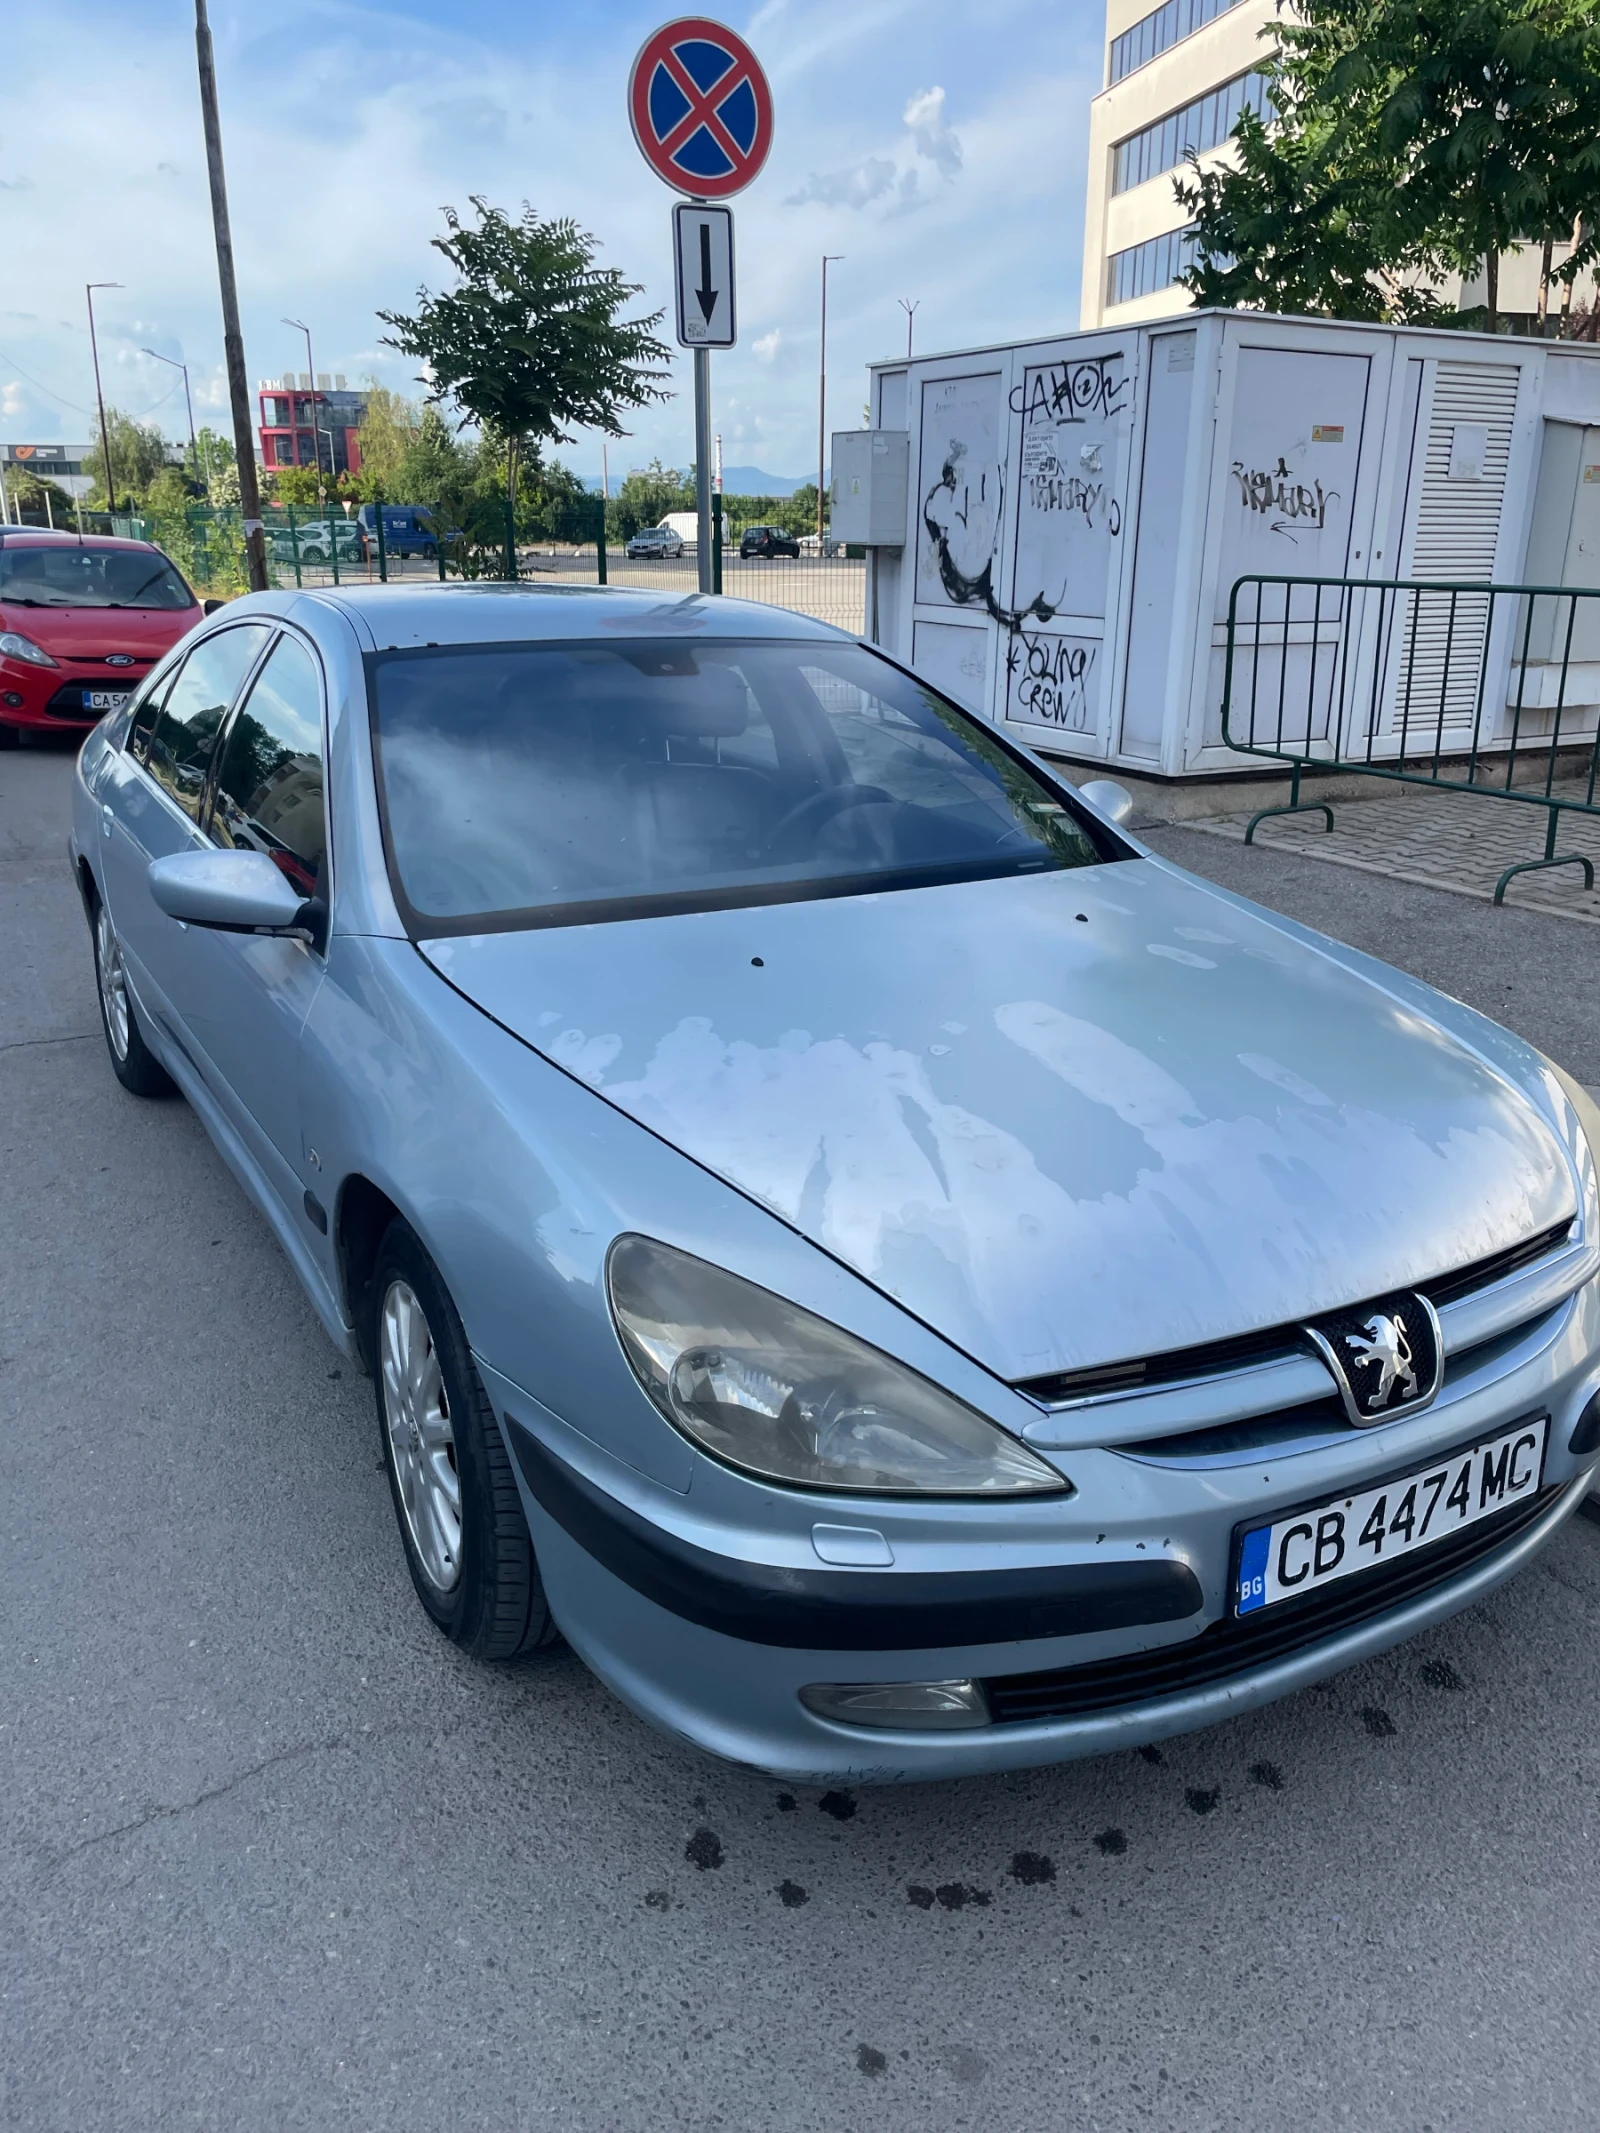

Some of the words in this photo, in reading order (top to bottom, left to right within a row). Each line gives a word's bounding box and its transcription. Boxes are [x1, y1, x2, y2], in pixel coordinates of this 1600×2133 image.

[93, 694, 110, 707] CA
[1277, 1511, 1345, 1587] CB
[1358, 1459, 1472, 1555] 4474
[1479, 1433, 1536, 1510] MC
[1241, 1576, 1262, 1602] BG
